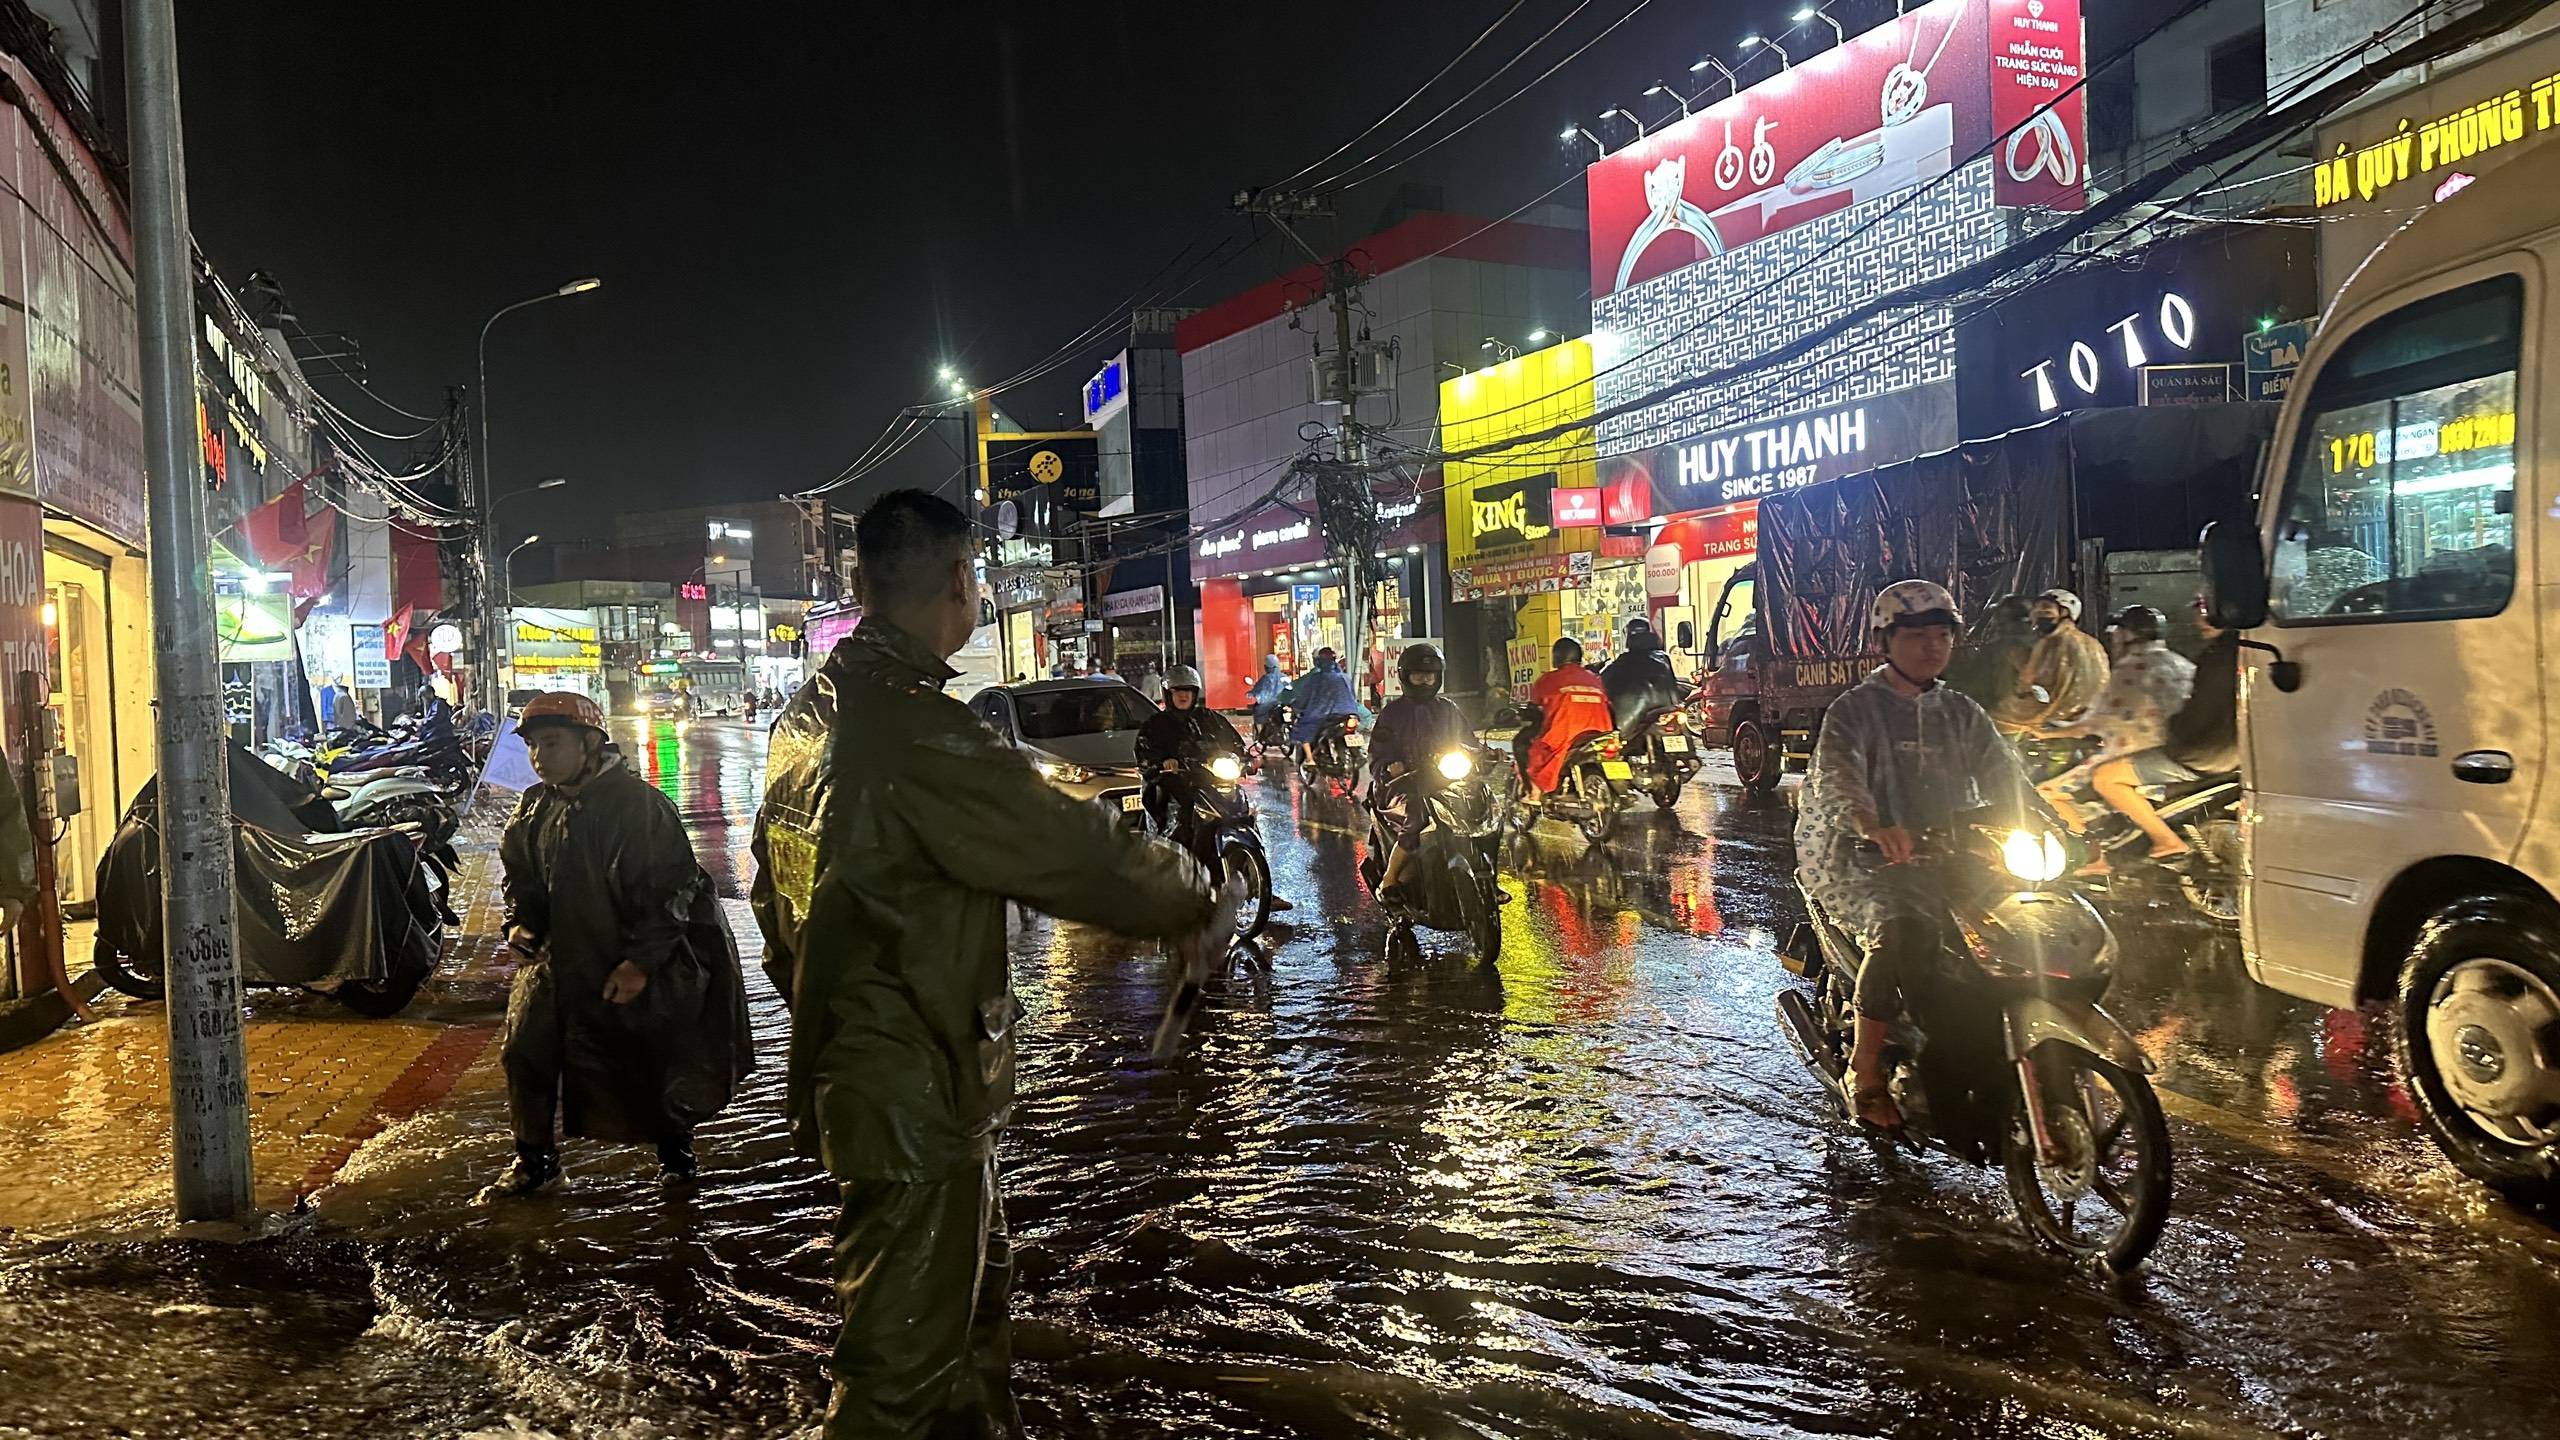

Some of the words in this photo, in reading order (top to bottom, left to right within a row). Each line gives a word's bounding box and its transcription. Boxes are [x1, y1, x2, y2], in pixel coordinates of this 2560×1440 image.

[2014, 17, 2030, 29] HUY
[2031, 19, 2058, 33] THANH
[2009, 40, 2038, 57] NHẪN
[2039, 47, 2064, 61] CƯỚI
[1995, 56, 2030, 71] TRANG
[2031, 58, 2051, 73] SỨC
[2051, 62, 2078, 77] VÀNG
[2016, 72, 2039, 89] HIỆN
[2041, 77, 2059, 92] ĐẠI
[2315, 142, 2350, 208] ĐÁ
[2356, 118, 2412, 202] QUÝ
[2419, 89, 2524, 173] PHONG
[2021, 292, 2193, 411] TOTO
[2271, 341, 2300, 367] BÀ
[2152, 376, 2182, 388] QUÁN
[2185, 375, 2199, 386] BÀ
[1679, 436, 1740, 486] HUY
[1744, 408, 1866, 472] THANH
[1721, 473, 1773, 500] SINCE
[1776, 464, 1818, 490] 1987
[1470, 490, 1526, 537] KING
[1524, 525, 1551, 541] Store
[1704, 539, 1741, 555] TRANG
[1743, 533, 1758, 550] SỨ
[0, 540, 39, 606] HOA
[1473, 573, 1502, 586] MUA
[1505, 572, 1512, 581] 1
[1516, 565, 1553, 581] ĐƯỢC
[1558, 565, 1568, 575] 4
[1628, 604, 1646, 613] SALE
[1521, 643, 1537, 664] KHO
